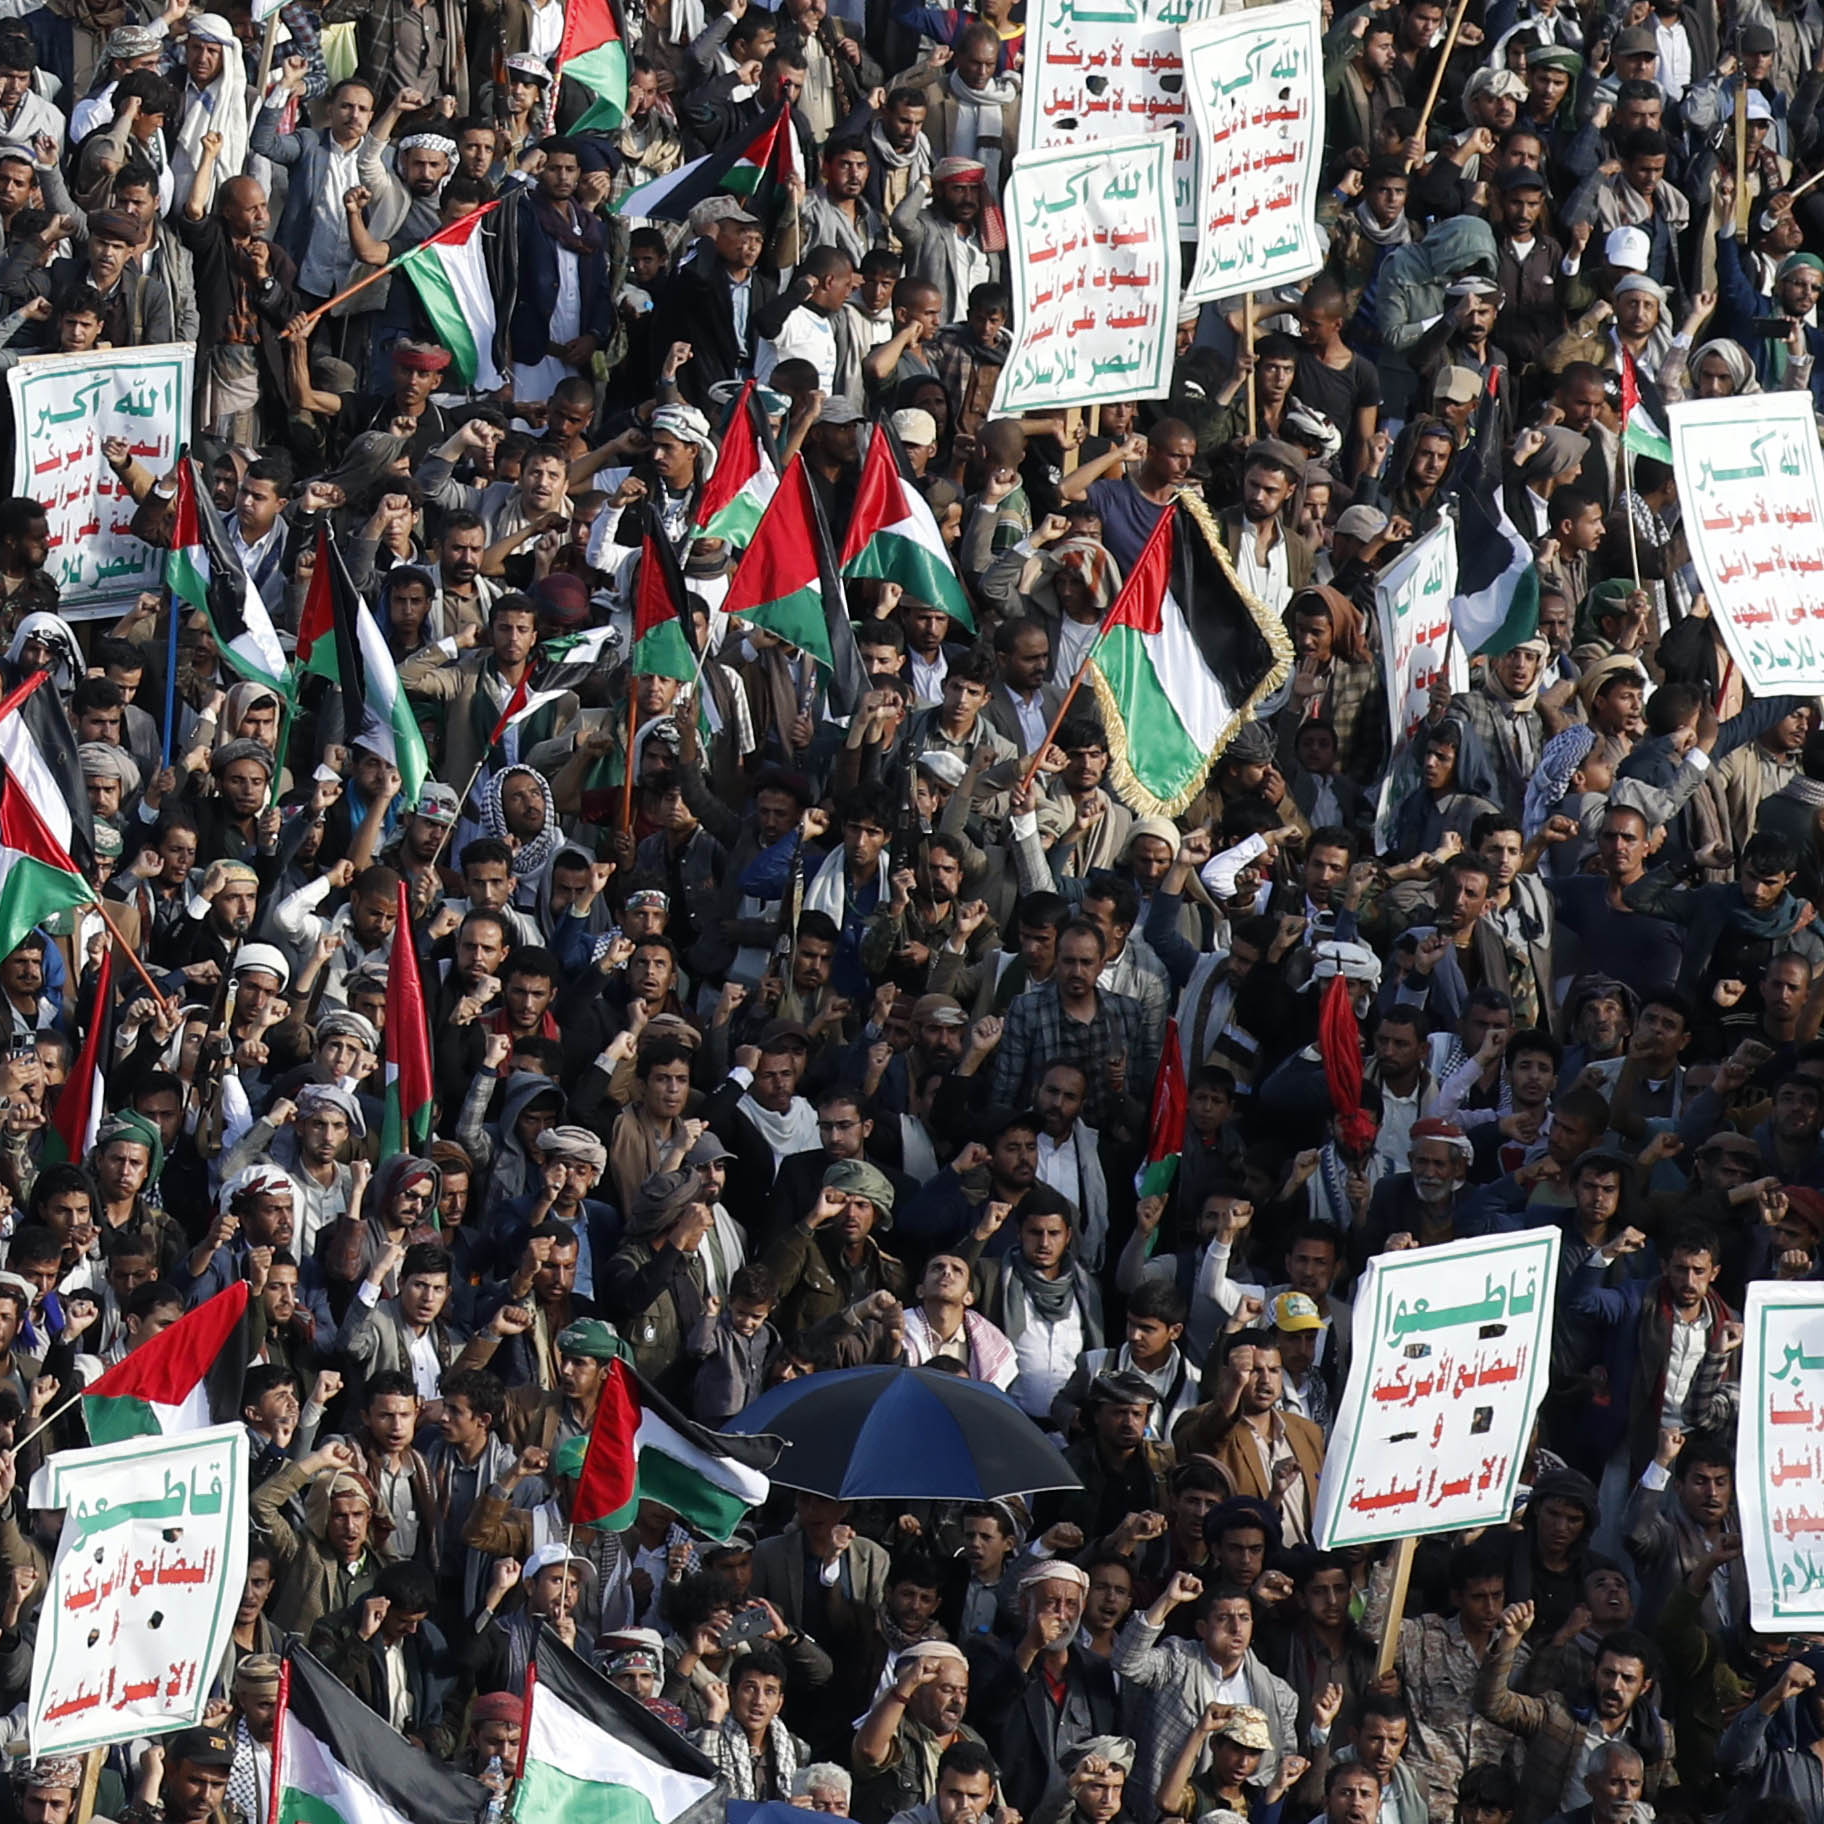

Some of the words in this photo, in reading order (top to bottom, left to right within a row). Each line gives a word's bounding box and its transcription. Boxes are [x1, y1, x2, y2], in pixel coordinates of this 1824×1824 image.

[1126, 92, 1190, 120] الموت
[1102, 162, 1154, 201] الله
[1091, 221, 1155, 251] الموت
[1091, 263, 1159, 293] الموت
[1088, 337, 1152, 384] النصر
